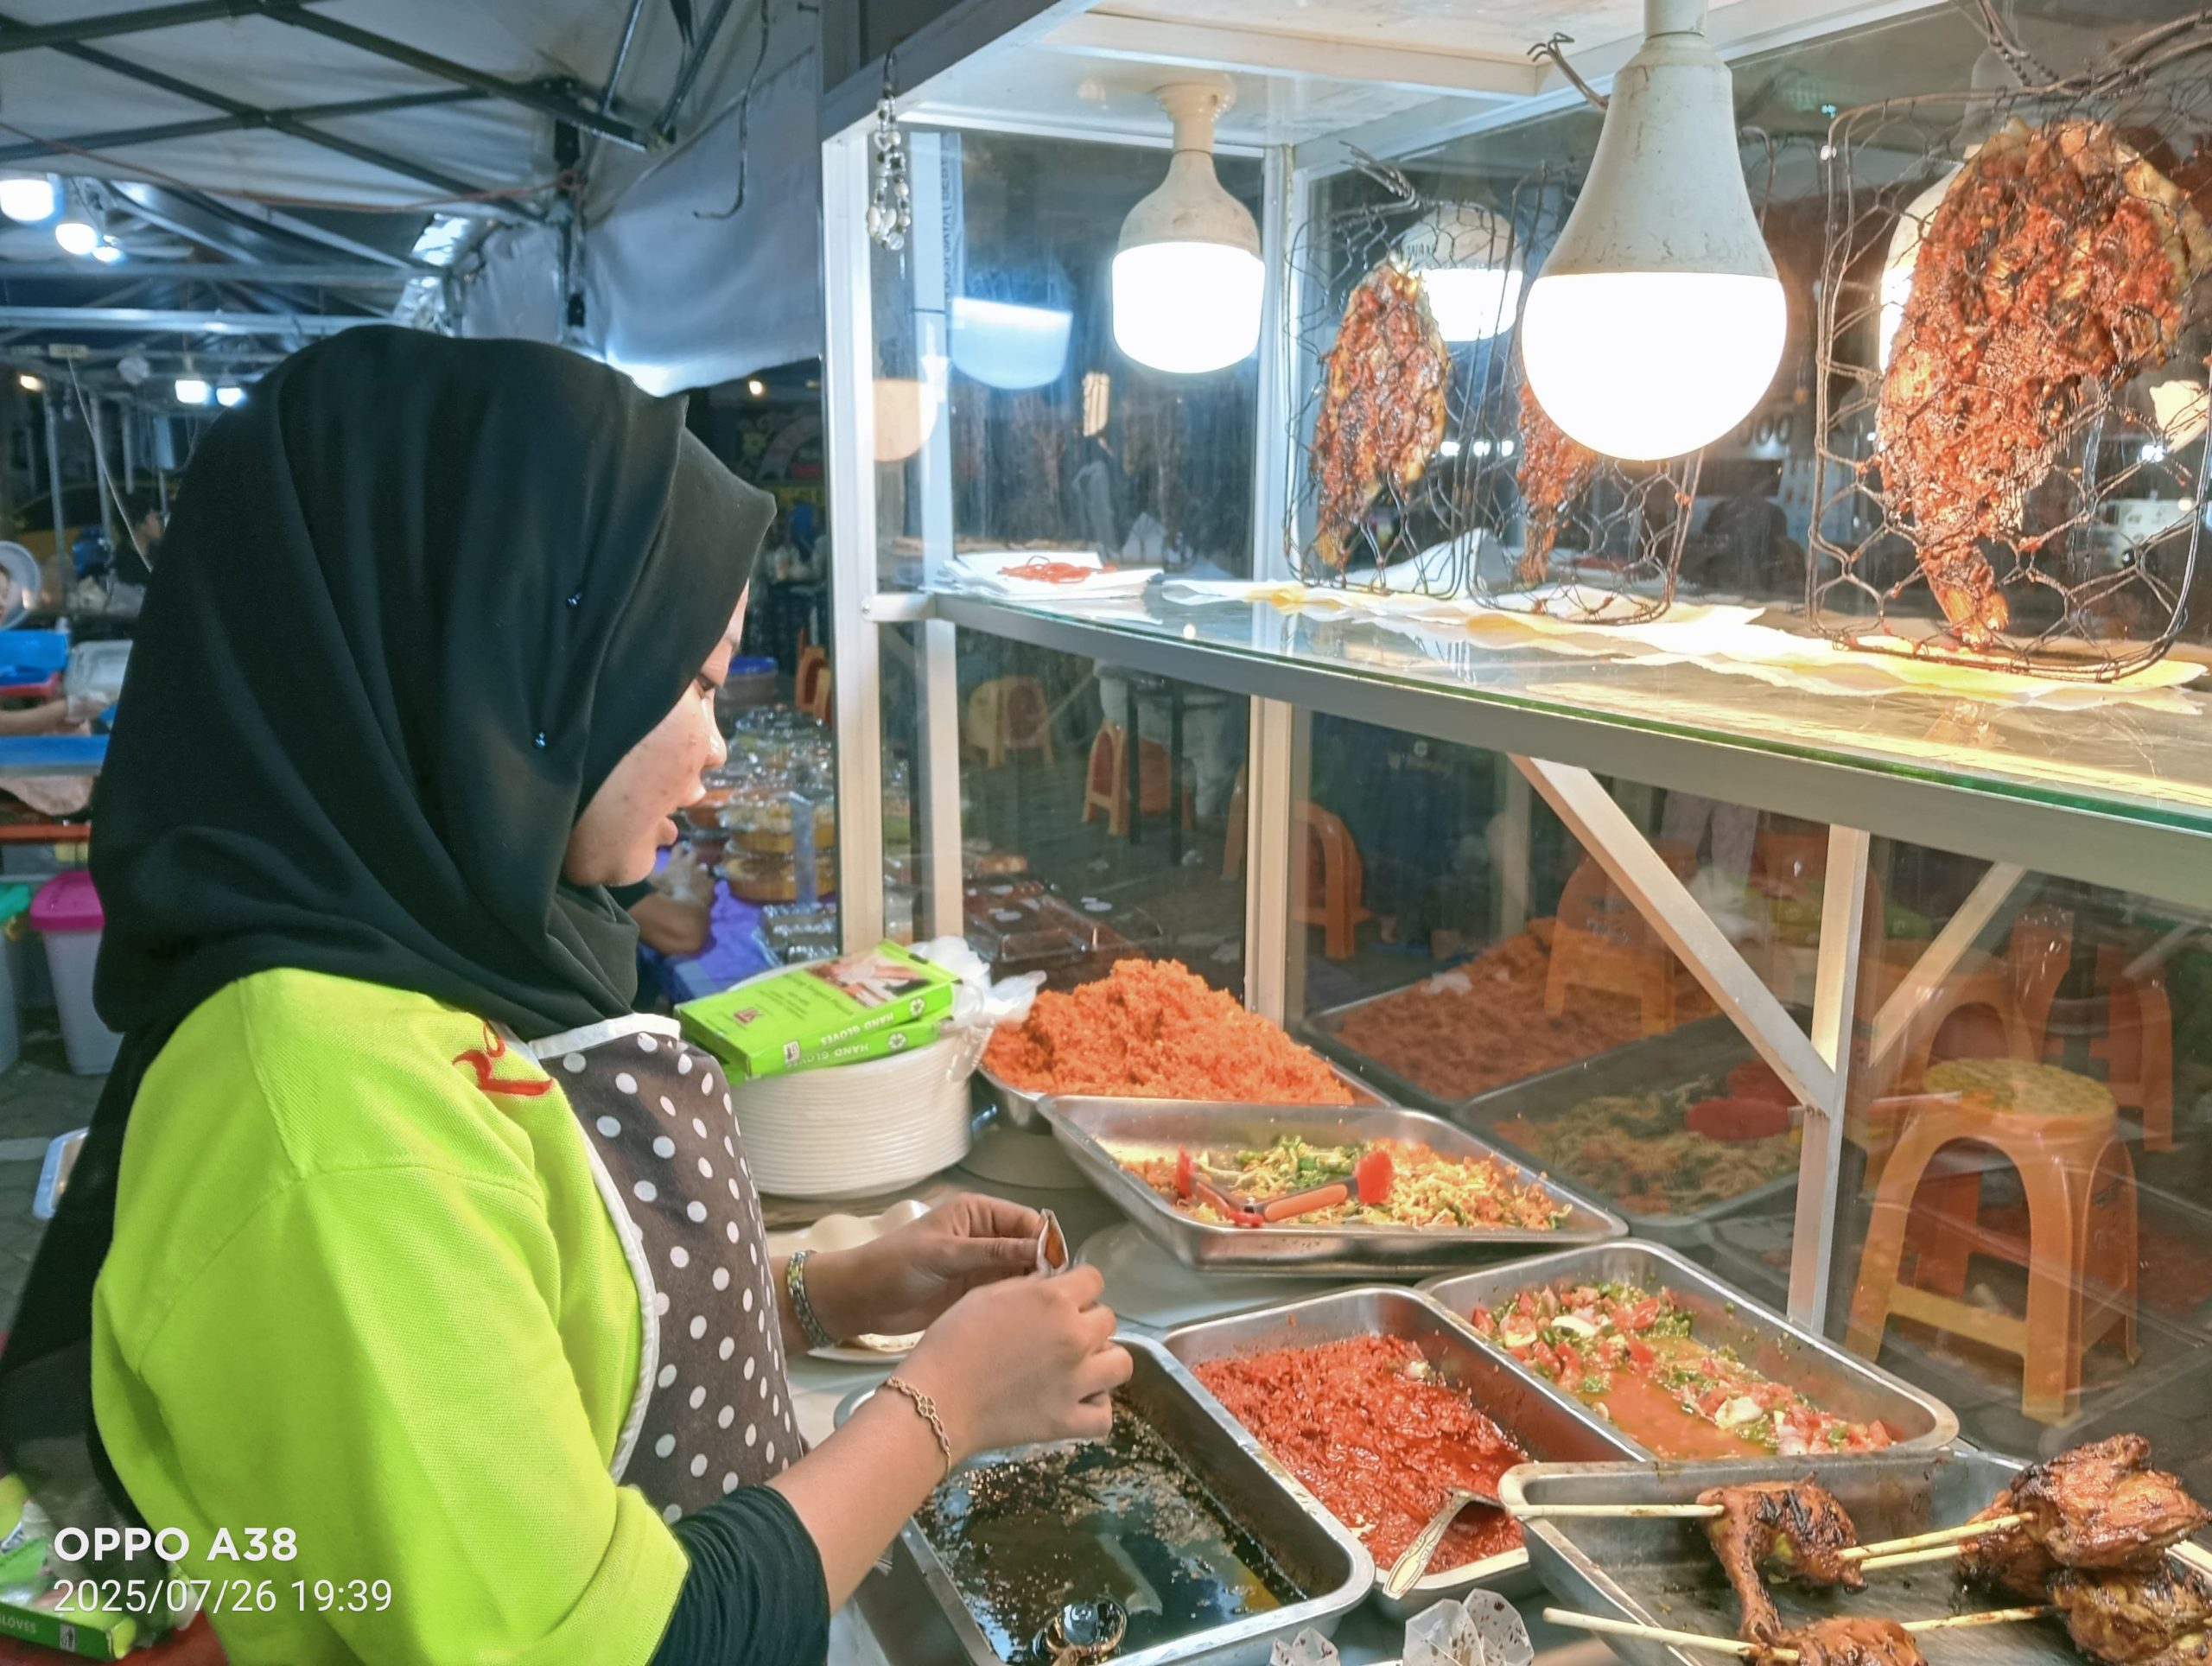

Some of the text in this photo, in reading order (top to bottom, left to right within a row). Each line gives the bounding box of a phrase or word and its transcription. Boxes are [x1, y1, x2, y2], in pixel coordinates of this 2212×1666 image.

[820, 1012, 894, 1046] HAND GLOVES
[834, 1043, 869, 1058] HAND
[0, 1614, 36, 1636] LOVES
